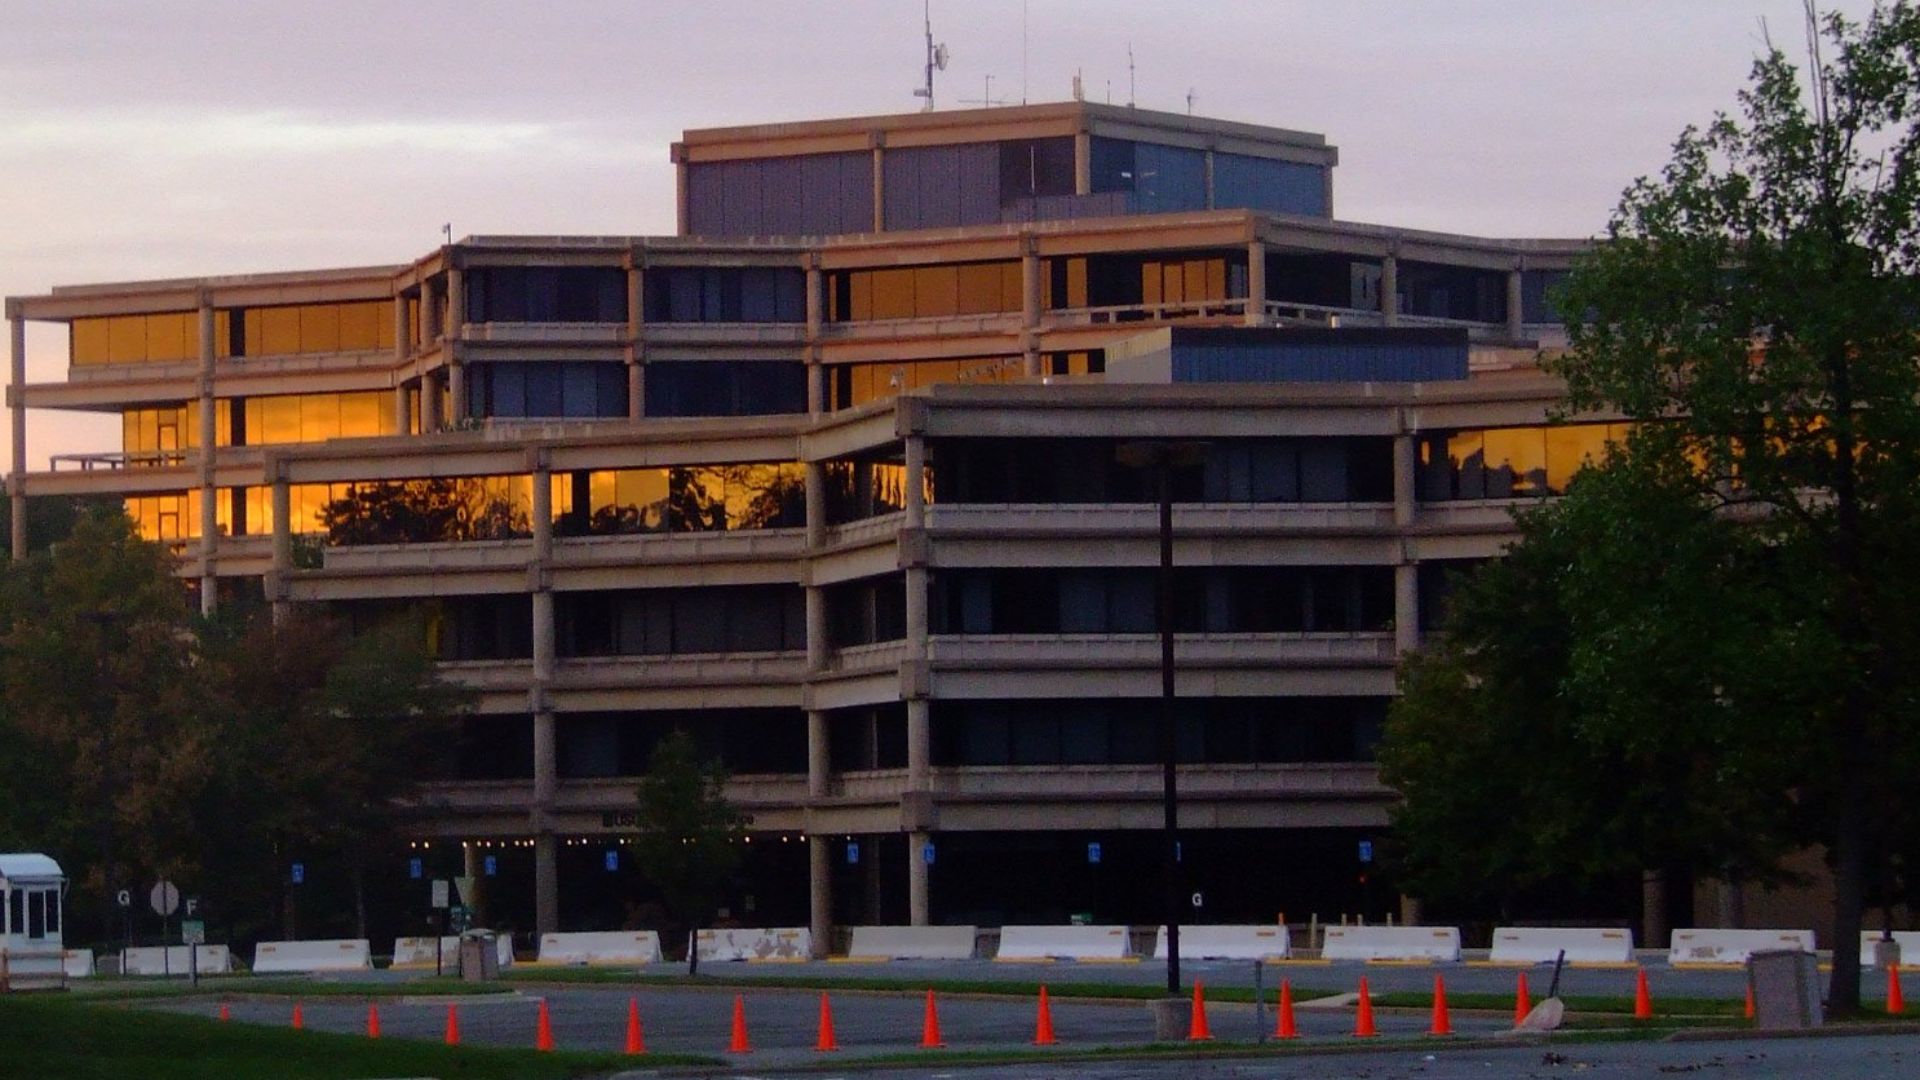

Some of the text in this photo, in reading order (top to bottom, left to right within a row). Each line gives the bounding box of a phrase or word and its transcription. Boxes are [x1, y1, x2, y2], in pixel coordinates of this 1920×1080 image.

[118, 890, 130, 906] G
[1192, 893, 1203, 907] G
[186, 899, 198, 915] F
